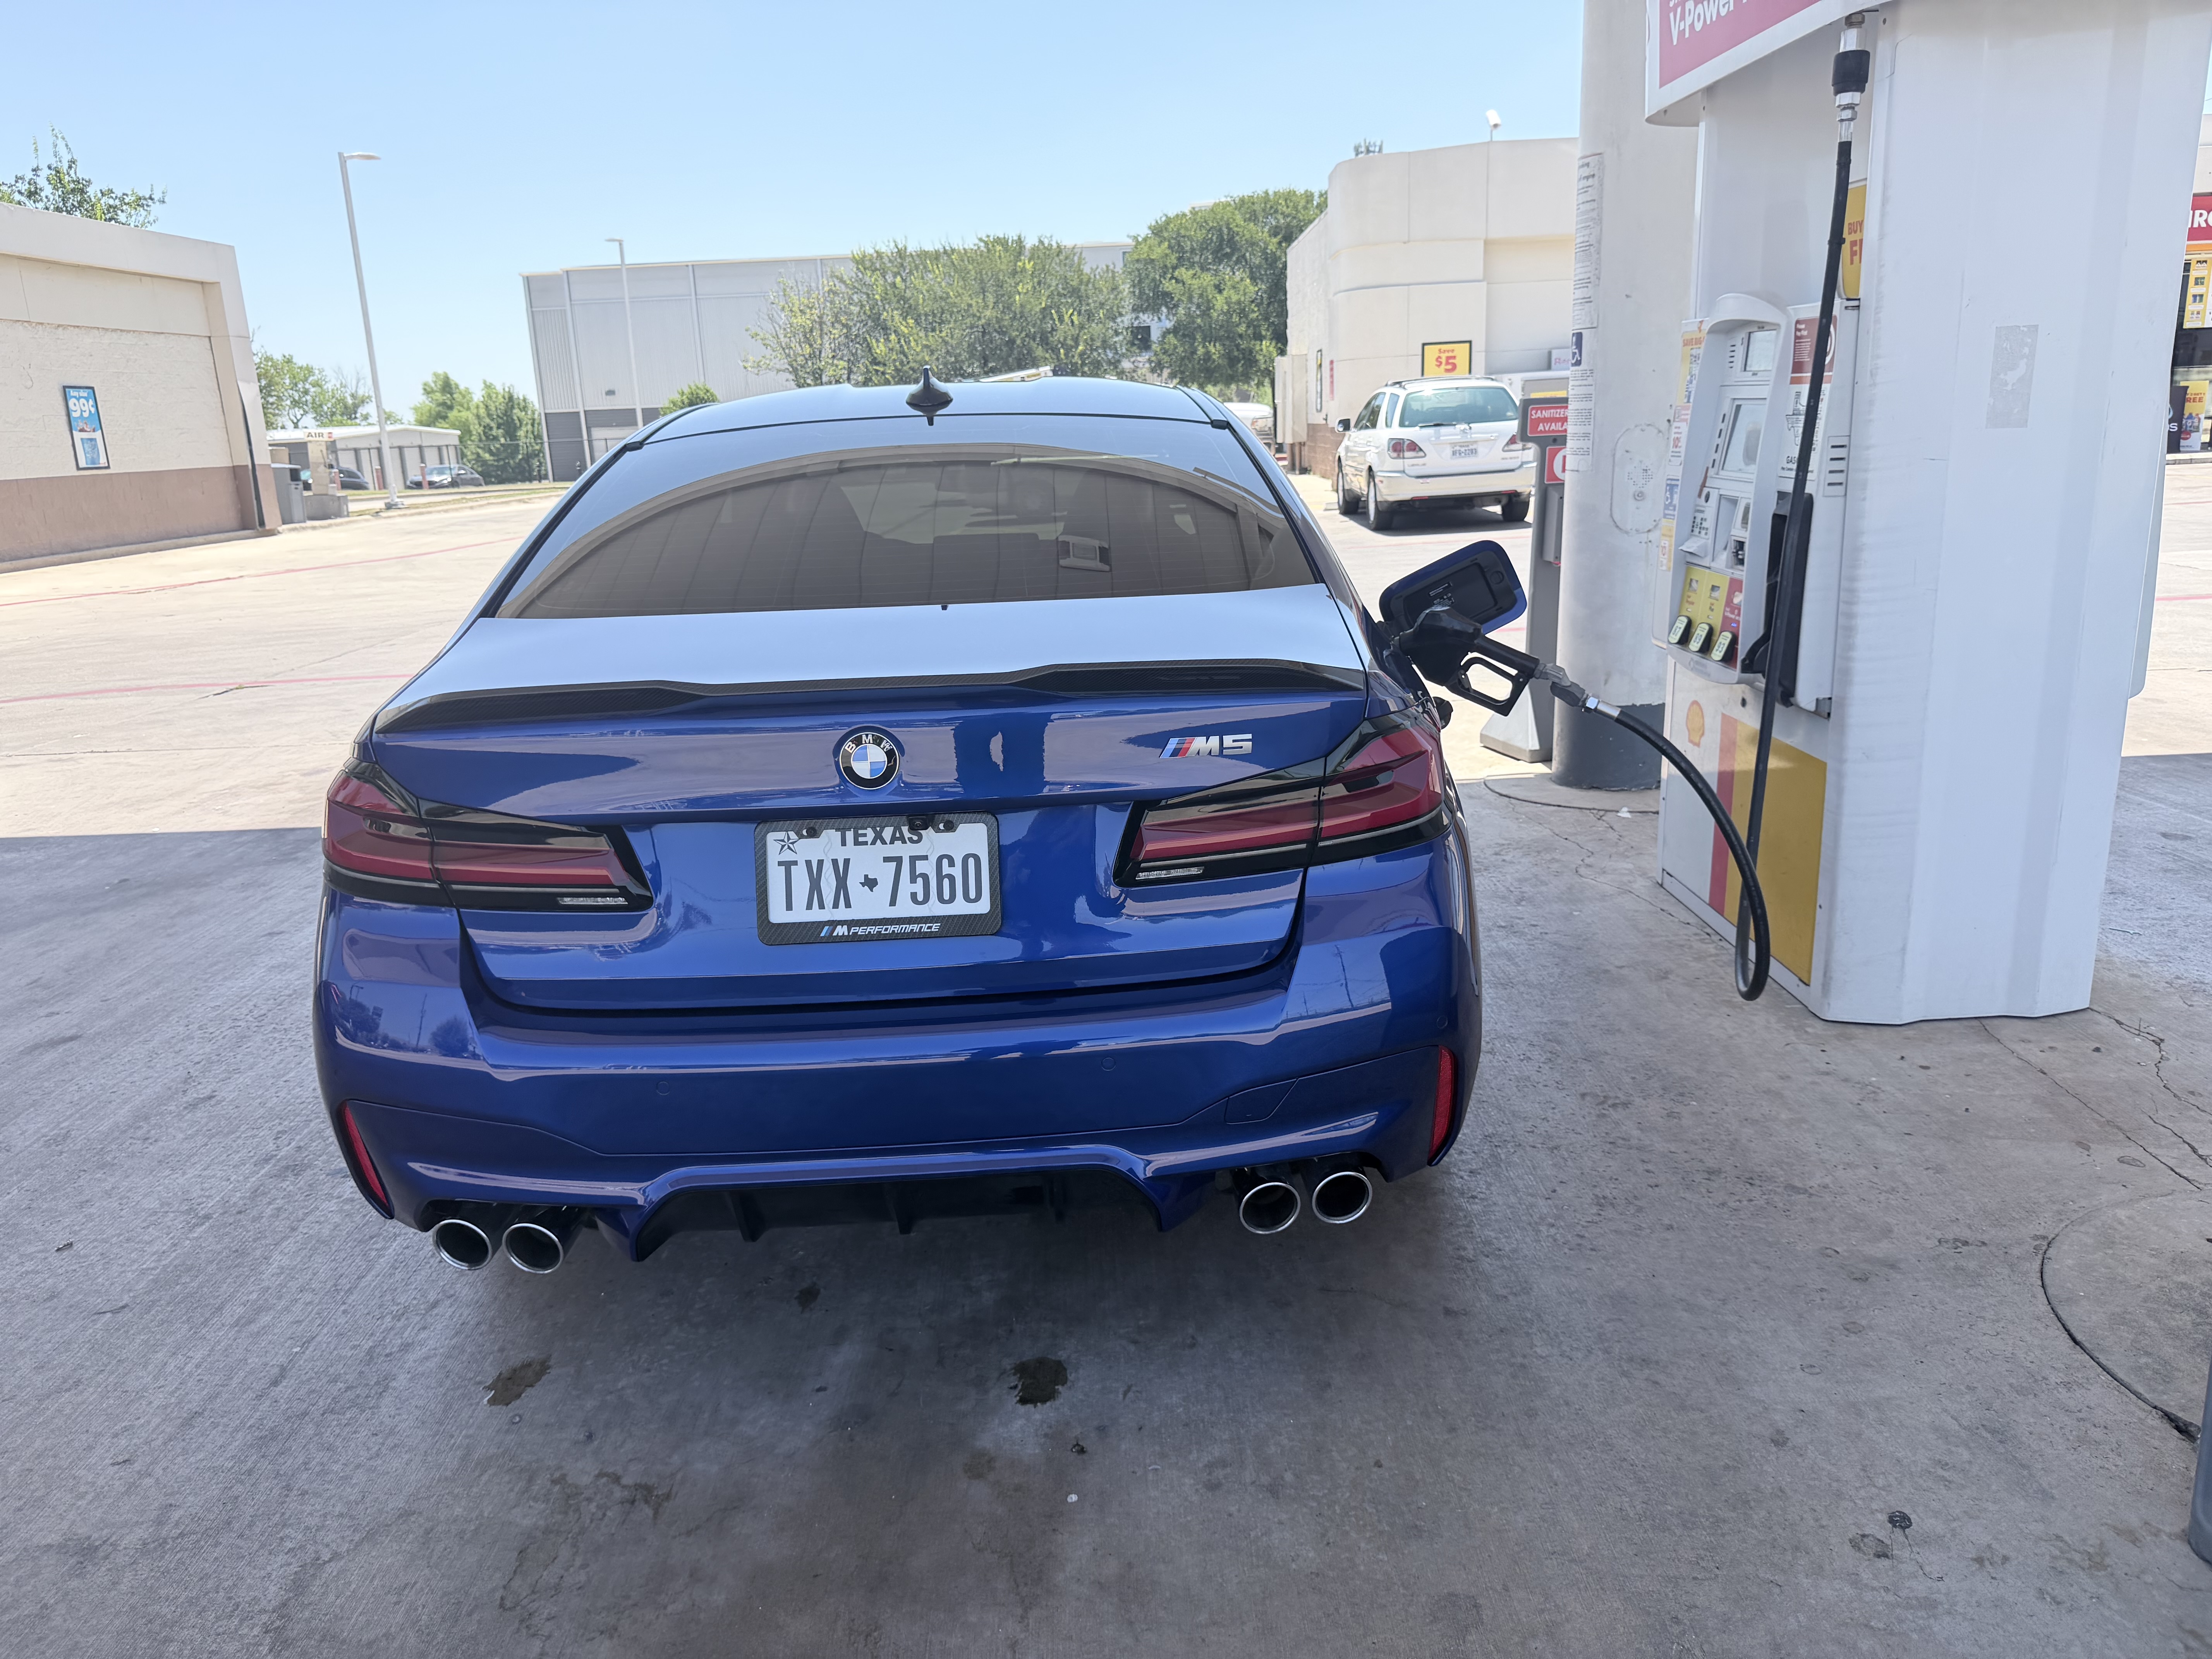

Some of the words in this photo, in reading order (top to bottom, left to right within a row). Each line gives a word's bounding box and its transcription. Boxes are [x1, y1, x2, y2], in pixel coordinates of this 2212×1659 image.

[1848, 220, 1863, 235] BUY
[1435, 356, 1457, 373] $5
[69, 398, 95, 417] 99¢
[1531, 409, 1568, 419] SANITIZER
[1537, 421, 1568, 431] AVAILA
[1716, 641, 1726, 653] 93
[845, 734, 893, 753] BMW
[1184, 733, 1252, 756] M5
[835, 826, 923, 847] TEXAS
[778, 858, 852, 912] TXX
[883, 853, 982, 907] 7560
[833, 925, 848, 936] M
[849, 923, 941, 935] PERFORMANCE
